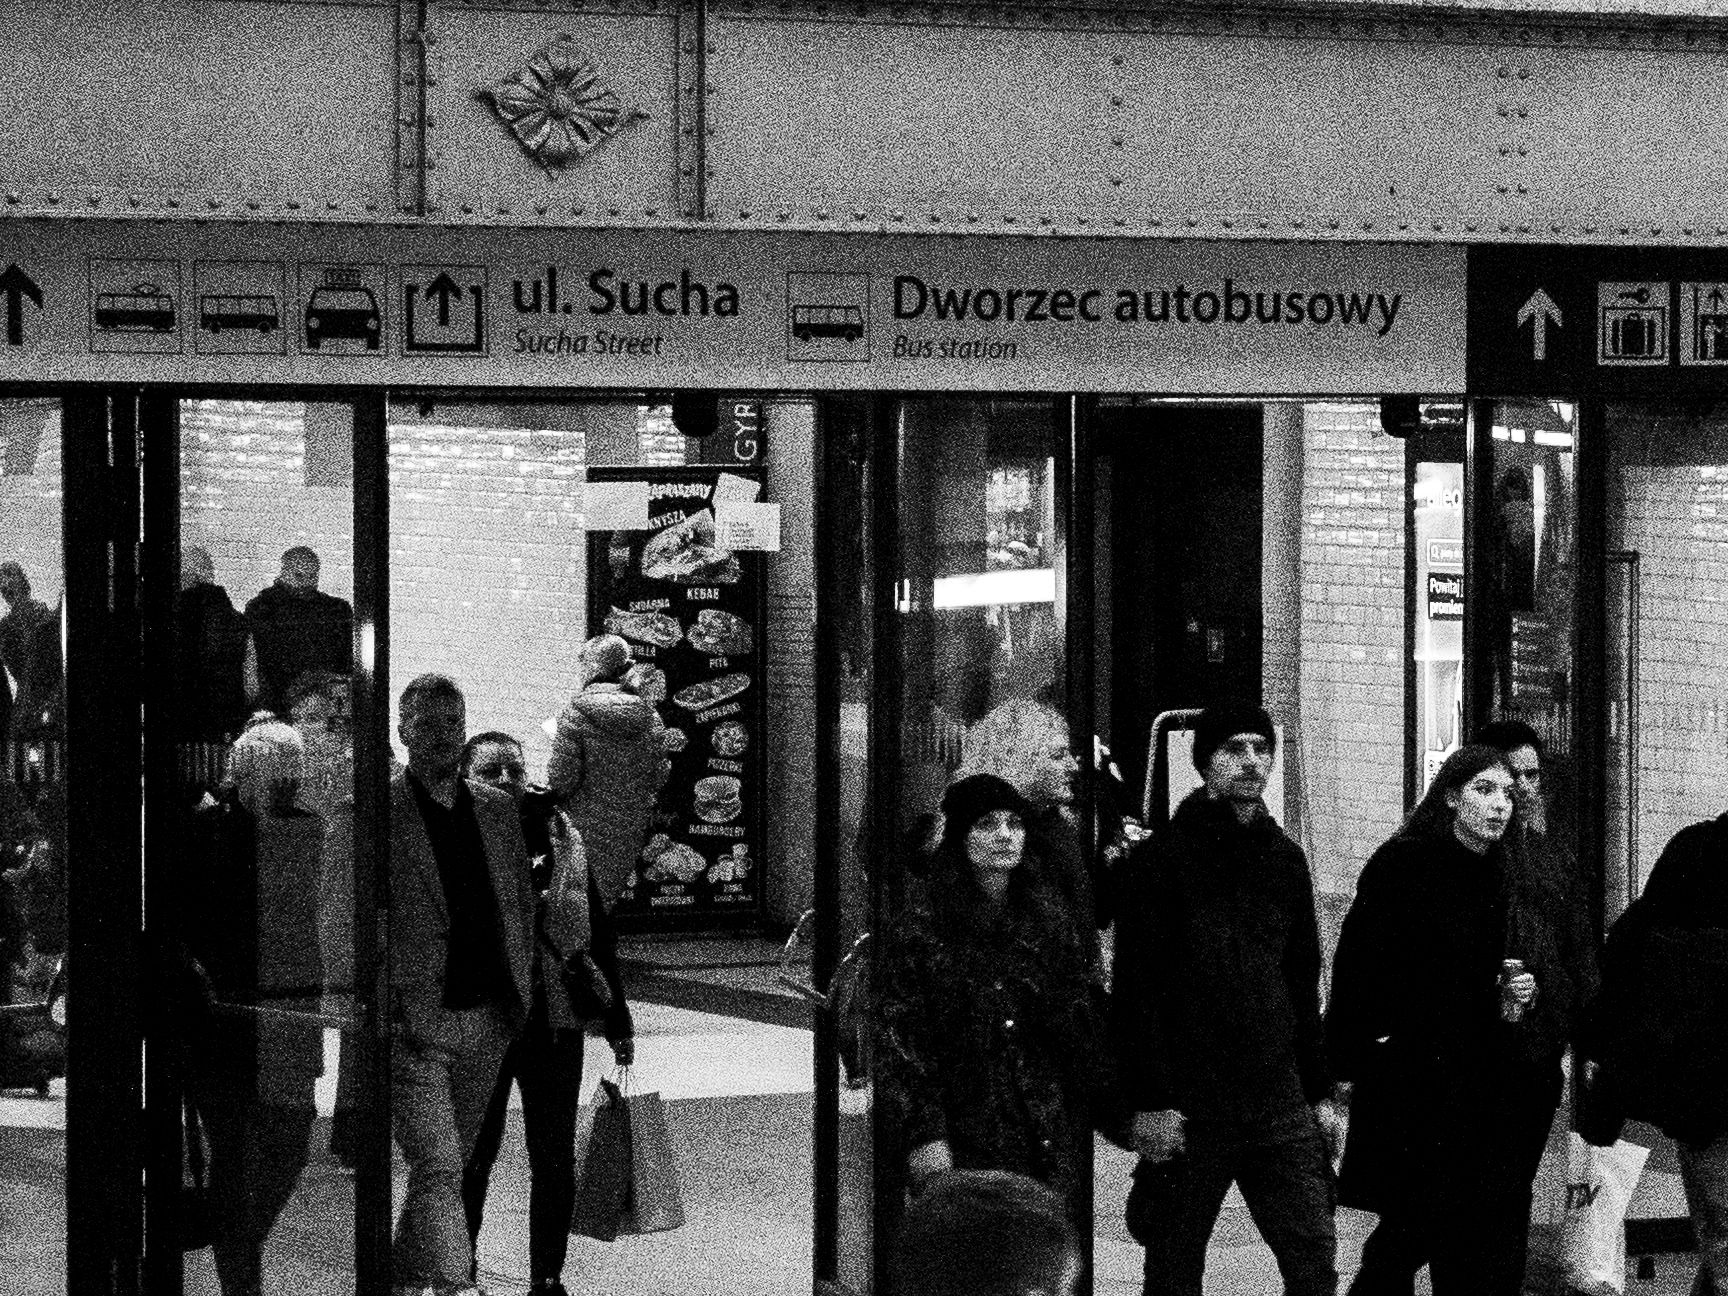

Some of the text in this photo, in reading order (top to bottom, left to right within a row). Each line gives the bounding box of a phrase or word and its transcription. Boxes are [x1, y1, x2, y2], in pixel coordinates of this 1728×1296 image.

[512, 266, 741, 318] ul. Sucha
[891, 274, 1402, 338] Dworzec autobusowy
[513, 329, 663, 356] Sucha Street
[892, 335, 1018, 361] Bus station
